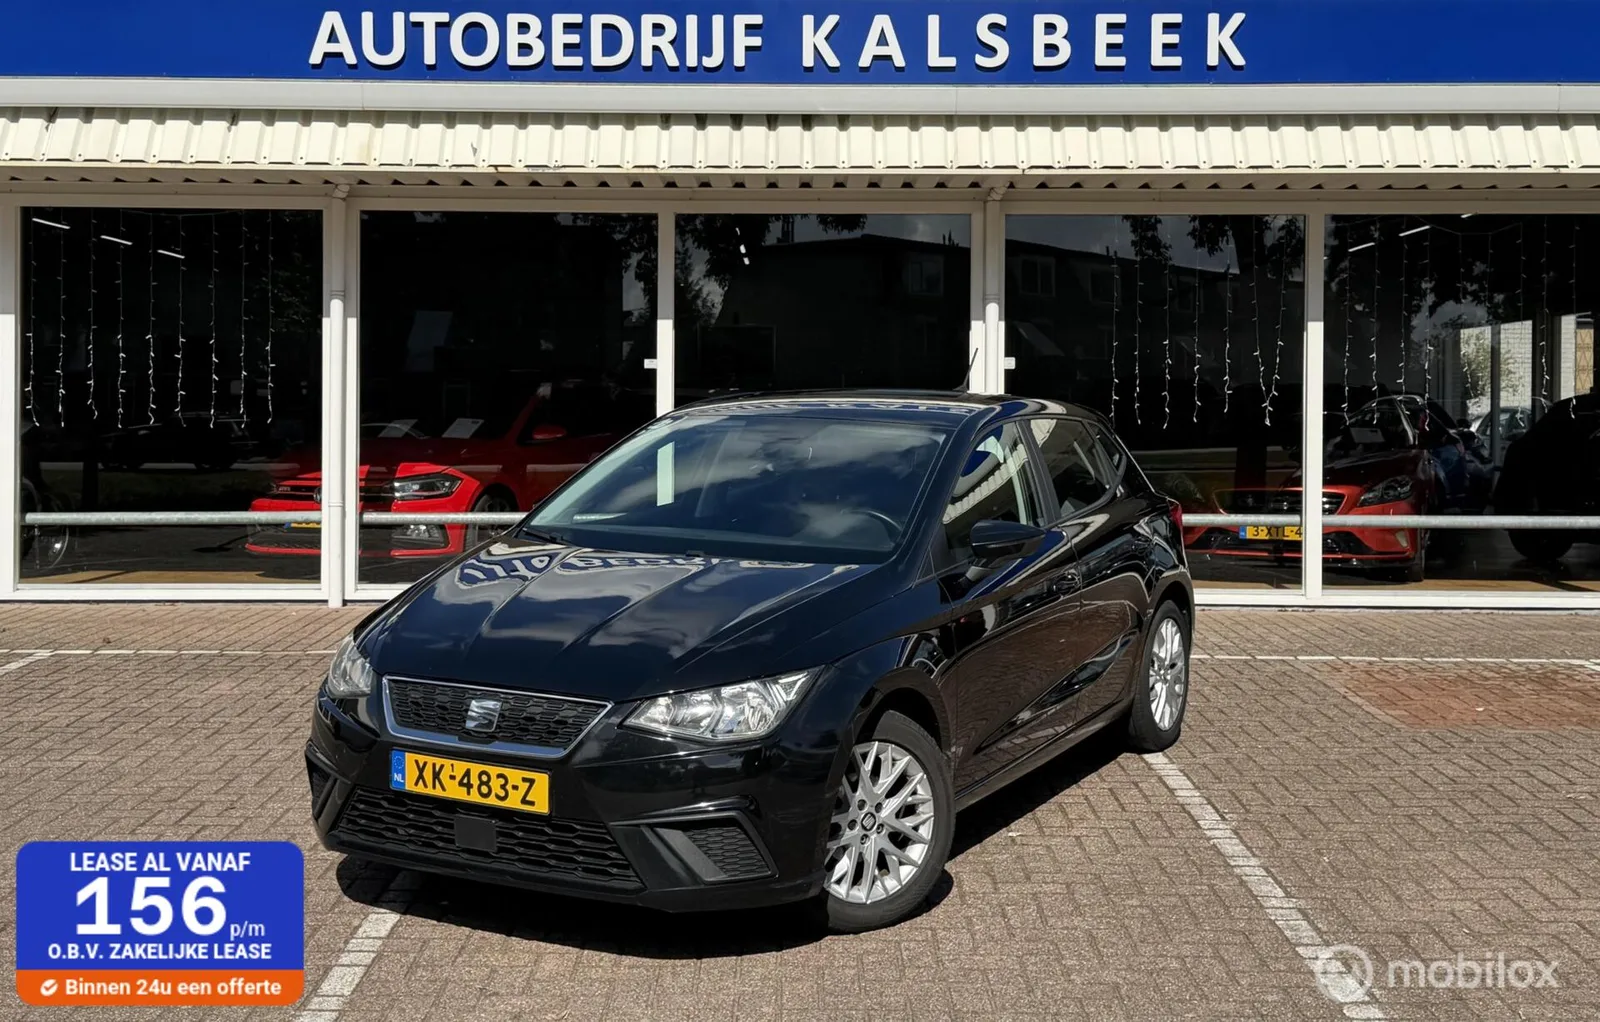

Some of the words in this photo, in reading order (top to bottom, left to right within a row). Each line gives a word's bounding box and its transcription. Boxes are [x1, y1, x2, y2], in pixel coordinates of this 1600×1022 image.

[308, 11, 763, 68] AUTOBEDRIJF
[802, 12, 1246, 68] KALSBEEK
[1252, 526, 1303, 538] 3-XTL-4
[393, 772, 404, 783] NL
[413, 759, 536, 807] XK-483-Z
